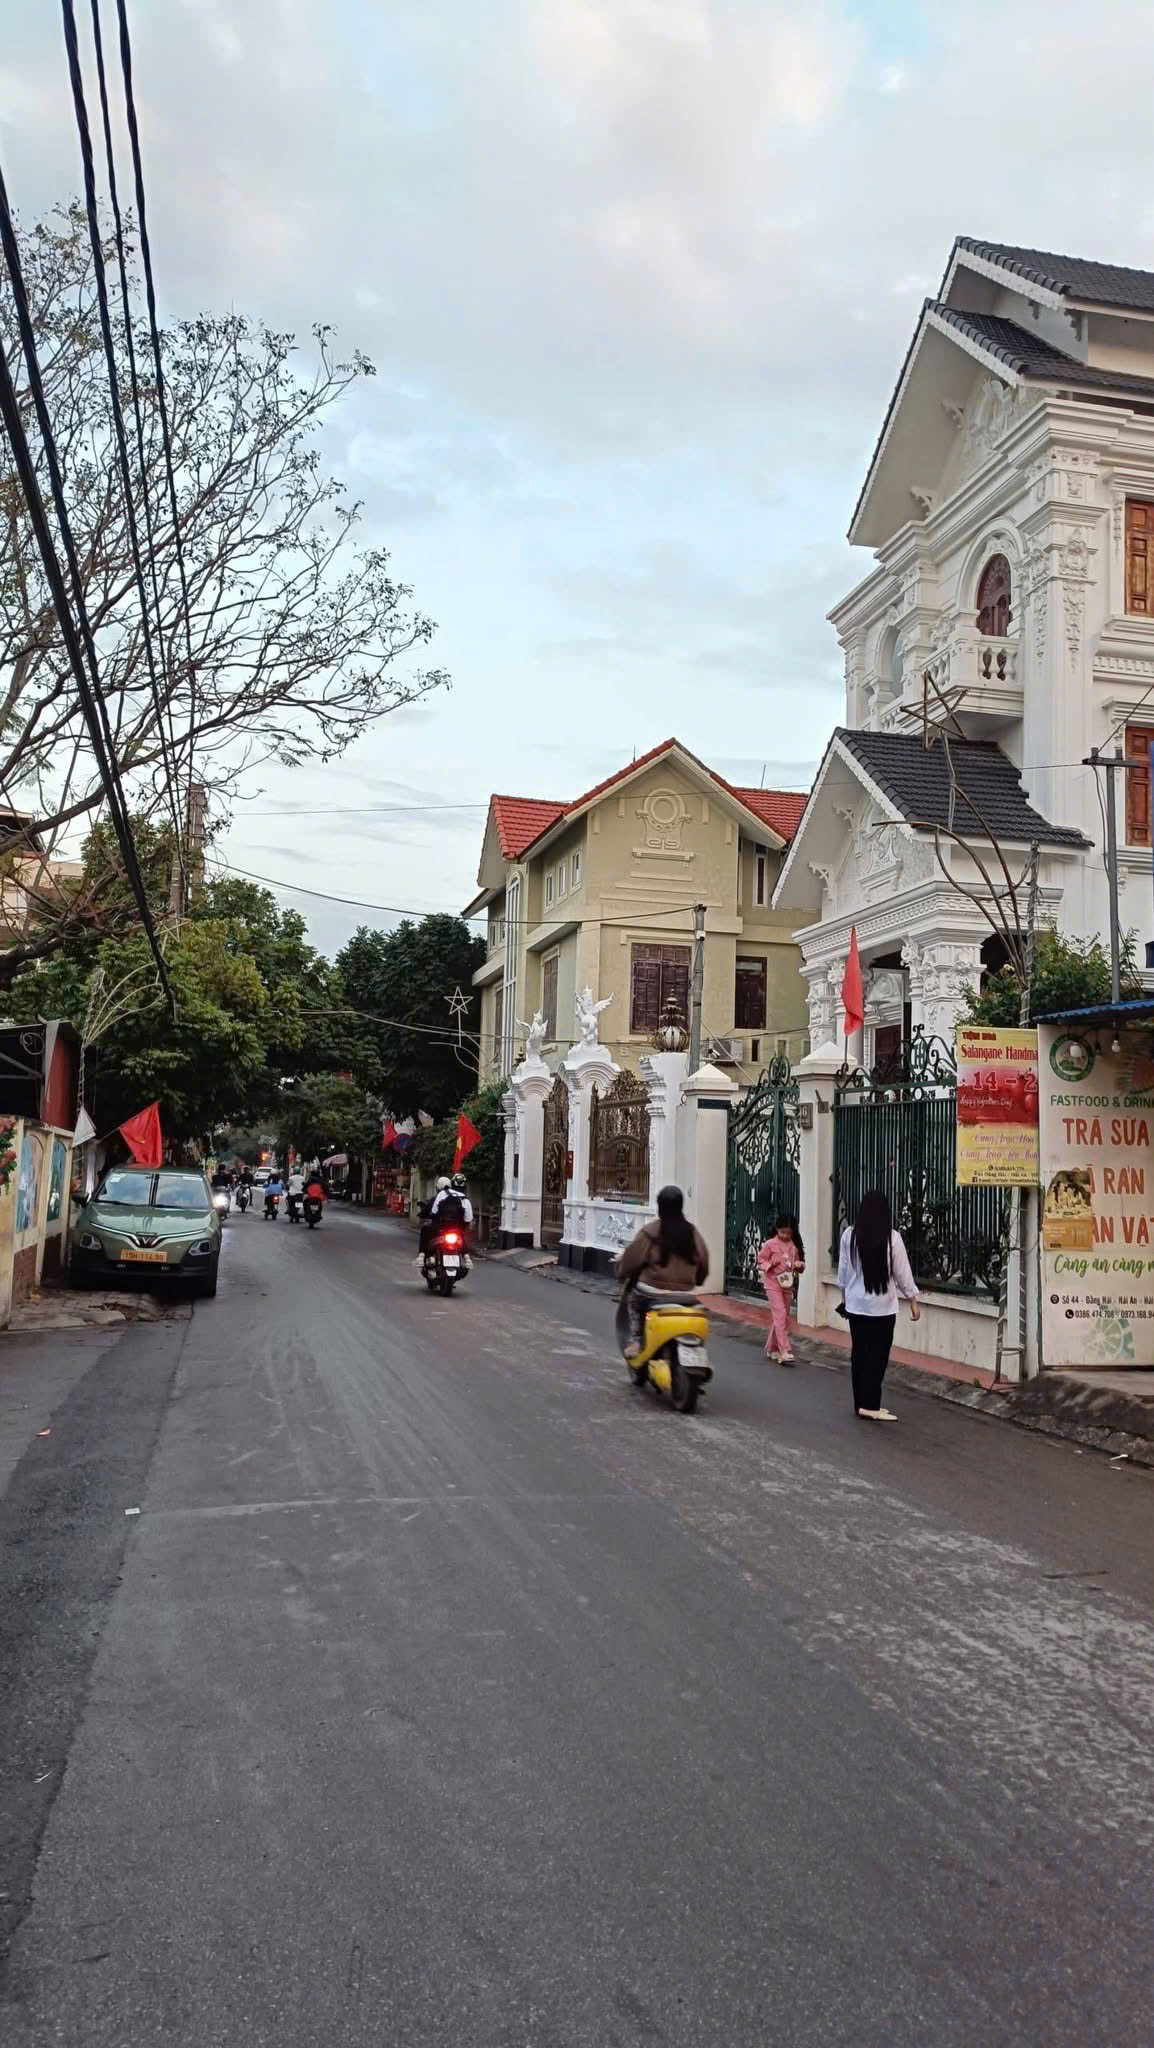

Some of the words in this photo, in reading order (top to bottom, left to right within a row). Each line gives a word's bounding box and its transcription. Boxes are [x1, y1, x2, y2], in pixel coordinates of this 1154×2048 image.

[961, 1044, 1002, 1062] Salangane
[973, 1071, 998, 1091] 14
[1050, 1095, 1109, 1107] FASTFOOD
[1112, 1096, 1120, 1107] &
[1111, 1115, 1150, 1147] SỮA
[1054, 1254, 1089, 1278] Càng
[1112, 1257, 1145, 1278] càng
[1071, 1295, 1079, 1304] 44
[1130, 1295, 1137, 1304] An
